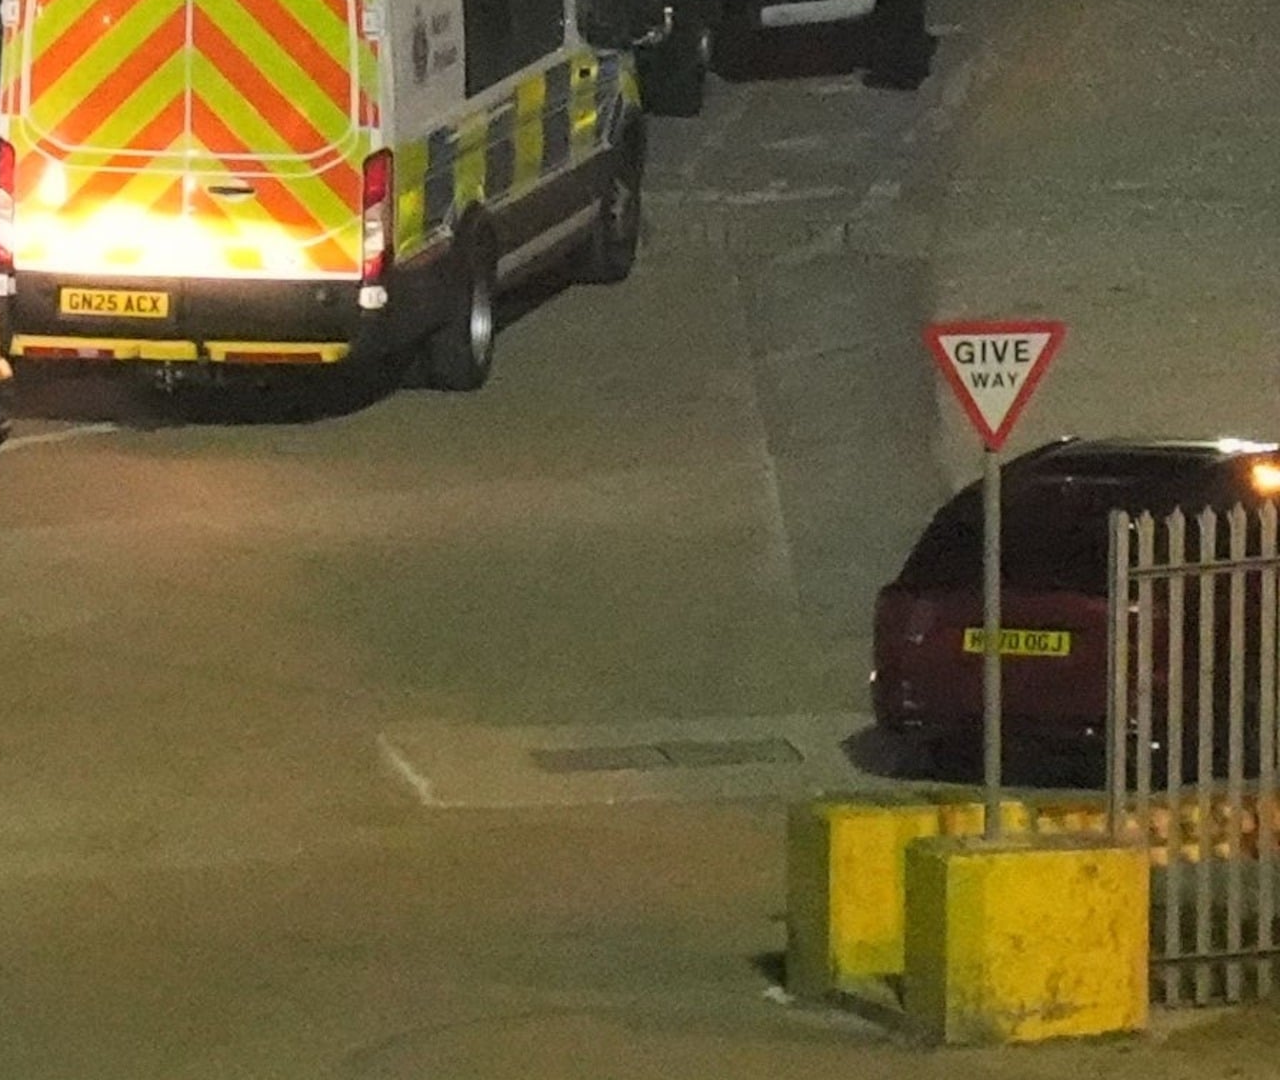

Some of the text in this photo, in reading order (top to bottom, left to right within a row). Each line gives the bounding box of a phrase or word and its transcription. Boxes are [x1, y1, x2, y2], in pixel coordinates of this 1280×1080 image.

[68, 292, 161, 313] GN25 ACX
[954, 340, 1031, 364] GIVE
[970, 371, 1019, 388] WAY
